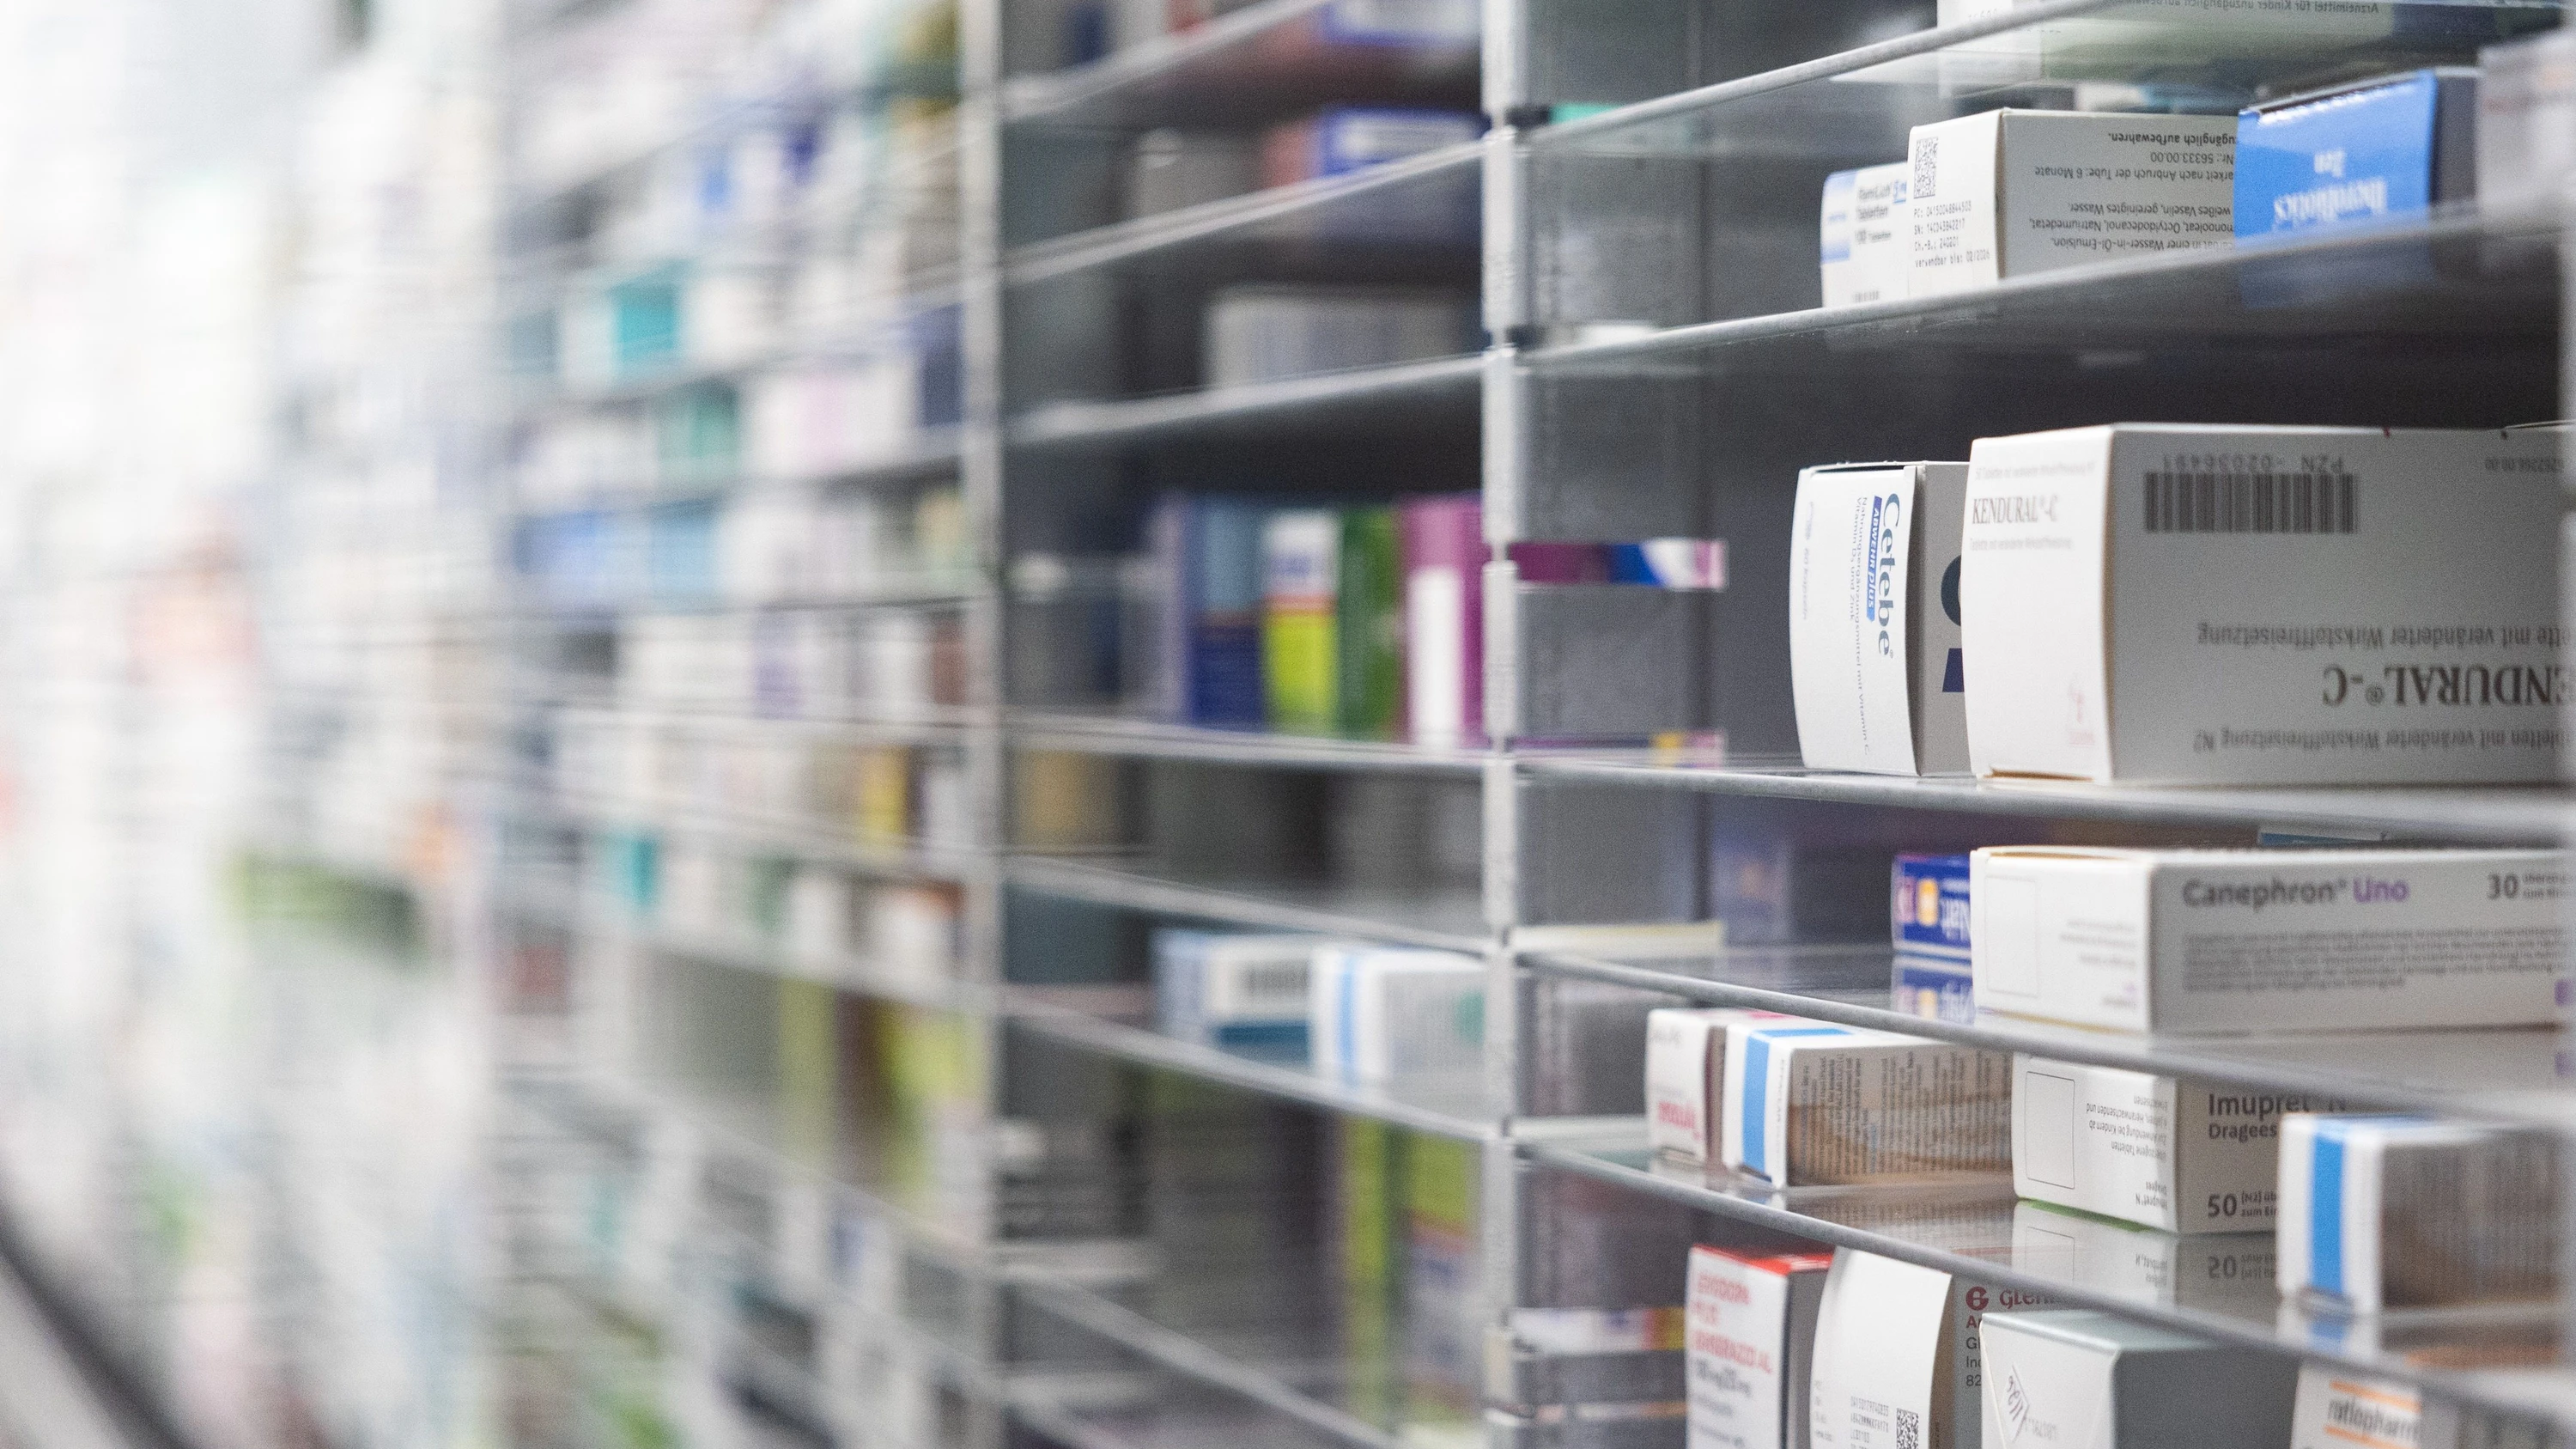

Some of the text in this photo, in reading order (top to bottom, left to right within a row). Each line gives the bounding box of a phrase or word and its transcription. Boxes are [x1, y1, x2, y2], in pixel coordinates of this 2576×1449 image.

[2108, 132, 2236, 146] ugänglich aufbewahren.
[2216, 153, 2234, 165] Nr.:
[2033, 167, 2234, 181] arkeit nach Anbruch der Tube: 6 Monate
[2068, 202, 2231, 216] weißes Vaselin, gereinigtes Wasser.
[2301, 454, 2344, 474] PZN
[1851, 497, 1862, 545] Vitamin
[1867, 508, 1880, 609] ABWEHR plus
[1855, 497, 1868, 666] Nahrungsergänzungsmittel
[2391, 625, 2495, 651] veränderter
[1858, 693, 1868, 741] Vitamin
[2353, 877, 2411, 904] Uno
[2487, 872, 2520, 901] 30
[2087, 1103, 2096, 1116] und
[2097, 1105, 2145, 1123] Heranwachsenden
[2089, 1120, 2096, 1130] ab
[2097, 1121, 2117, 1135] Kindern
[2117, 1125, 2126, 1139] bei
[2126, 1124, 2157, 1144] Anwendung
[2208, 1122, 2278, 1144] Dragees
[2111, 1141, 2136, 1157] Tabletten
[2207, 1193, 2238, 1219] 50
[1965, 1374, 1982, 1387] 82
